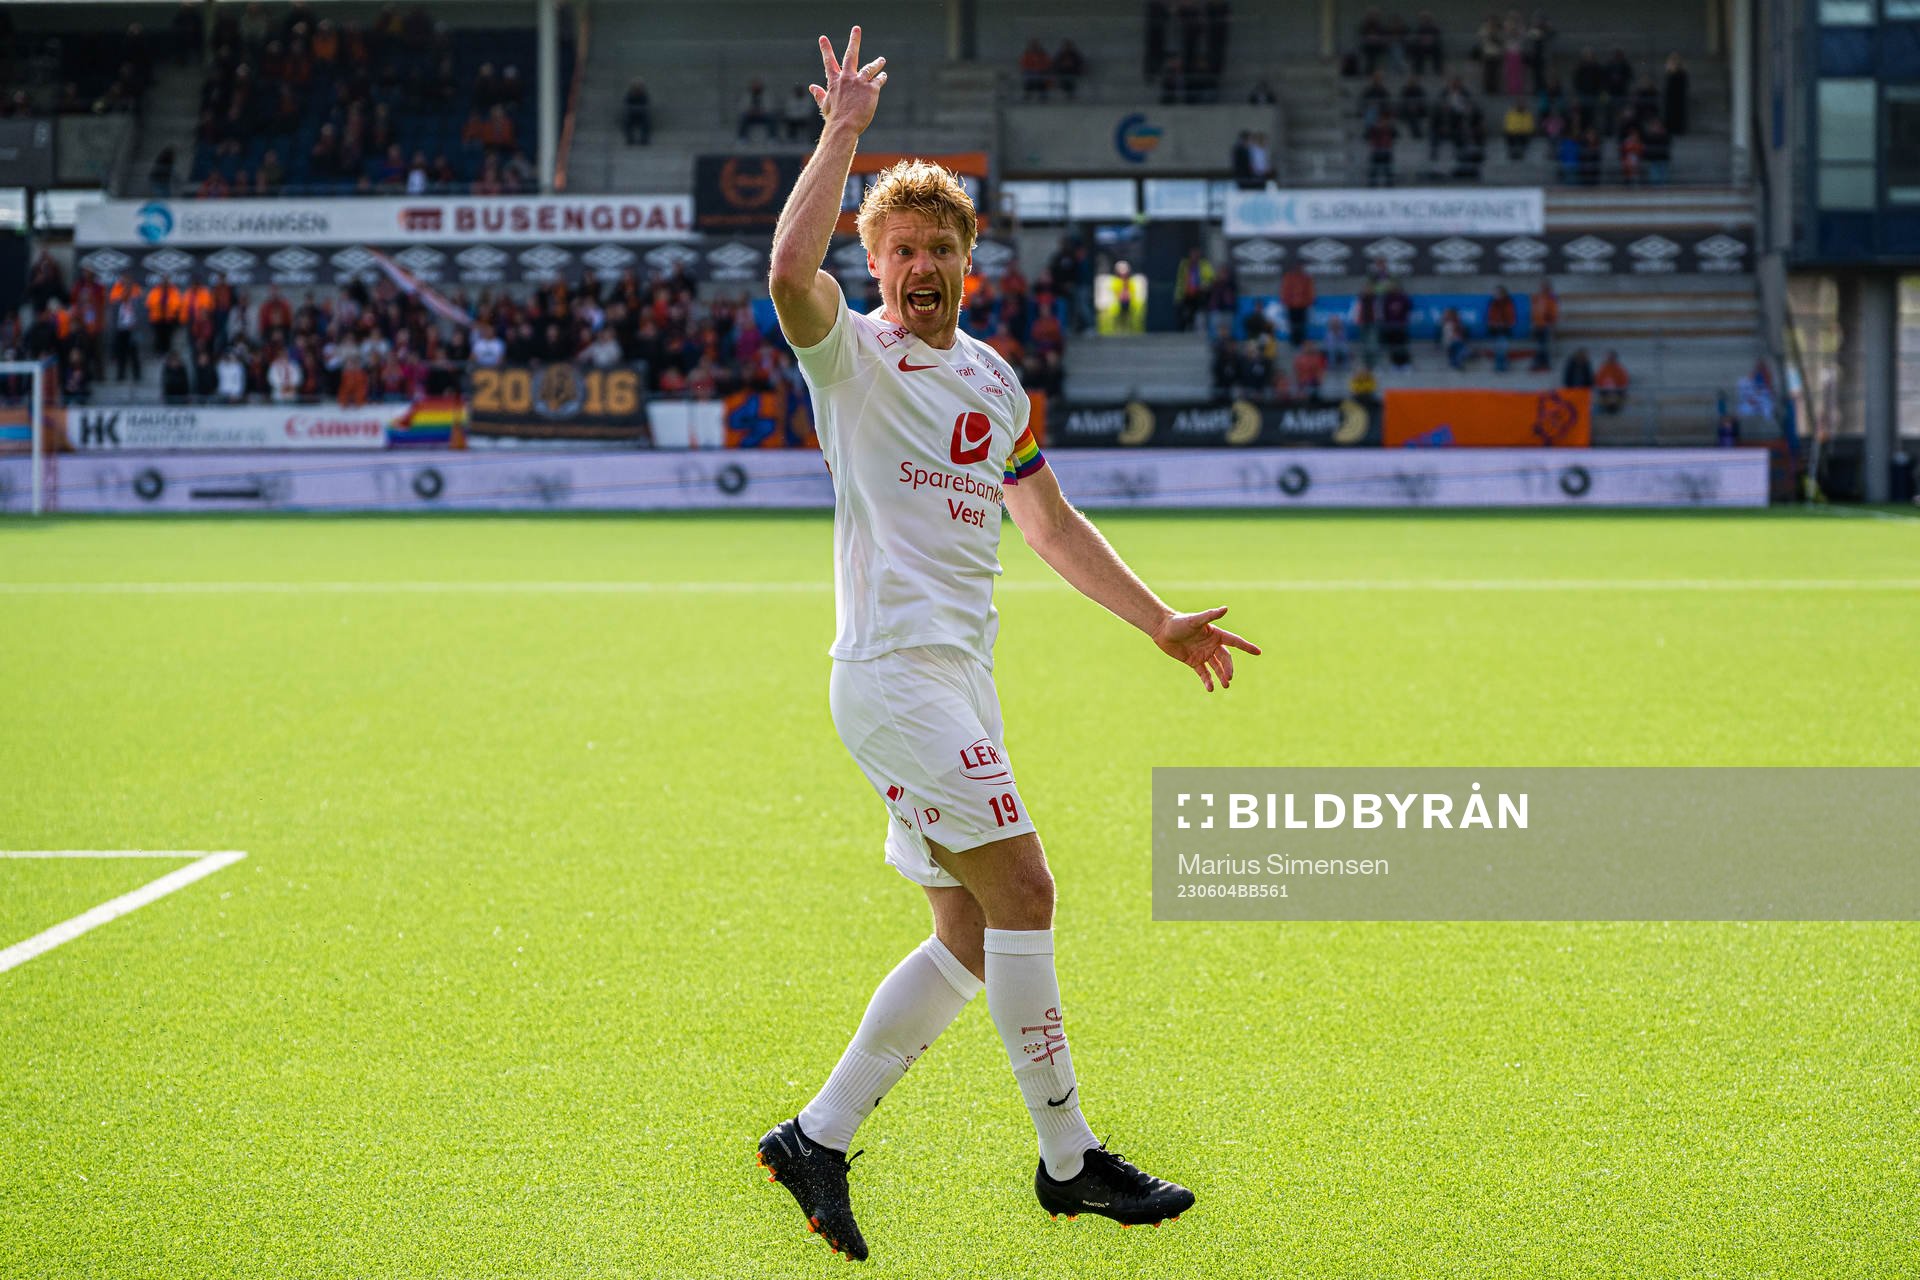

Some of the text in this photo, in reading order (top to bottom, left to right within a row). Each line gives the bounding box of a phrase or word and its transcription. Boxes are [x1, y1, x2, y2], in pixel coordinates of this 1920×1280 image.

[454, 204, 693, 233] BUSENGDAL
[470, 368, 639, 415] 20 16
[80, 410, 121, 446] HK
[284, 414, 382, 438] Canon
[947, 498, 986, 528] Vest
[988, 792, 1019, 828] 19
